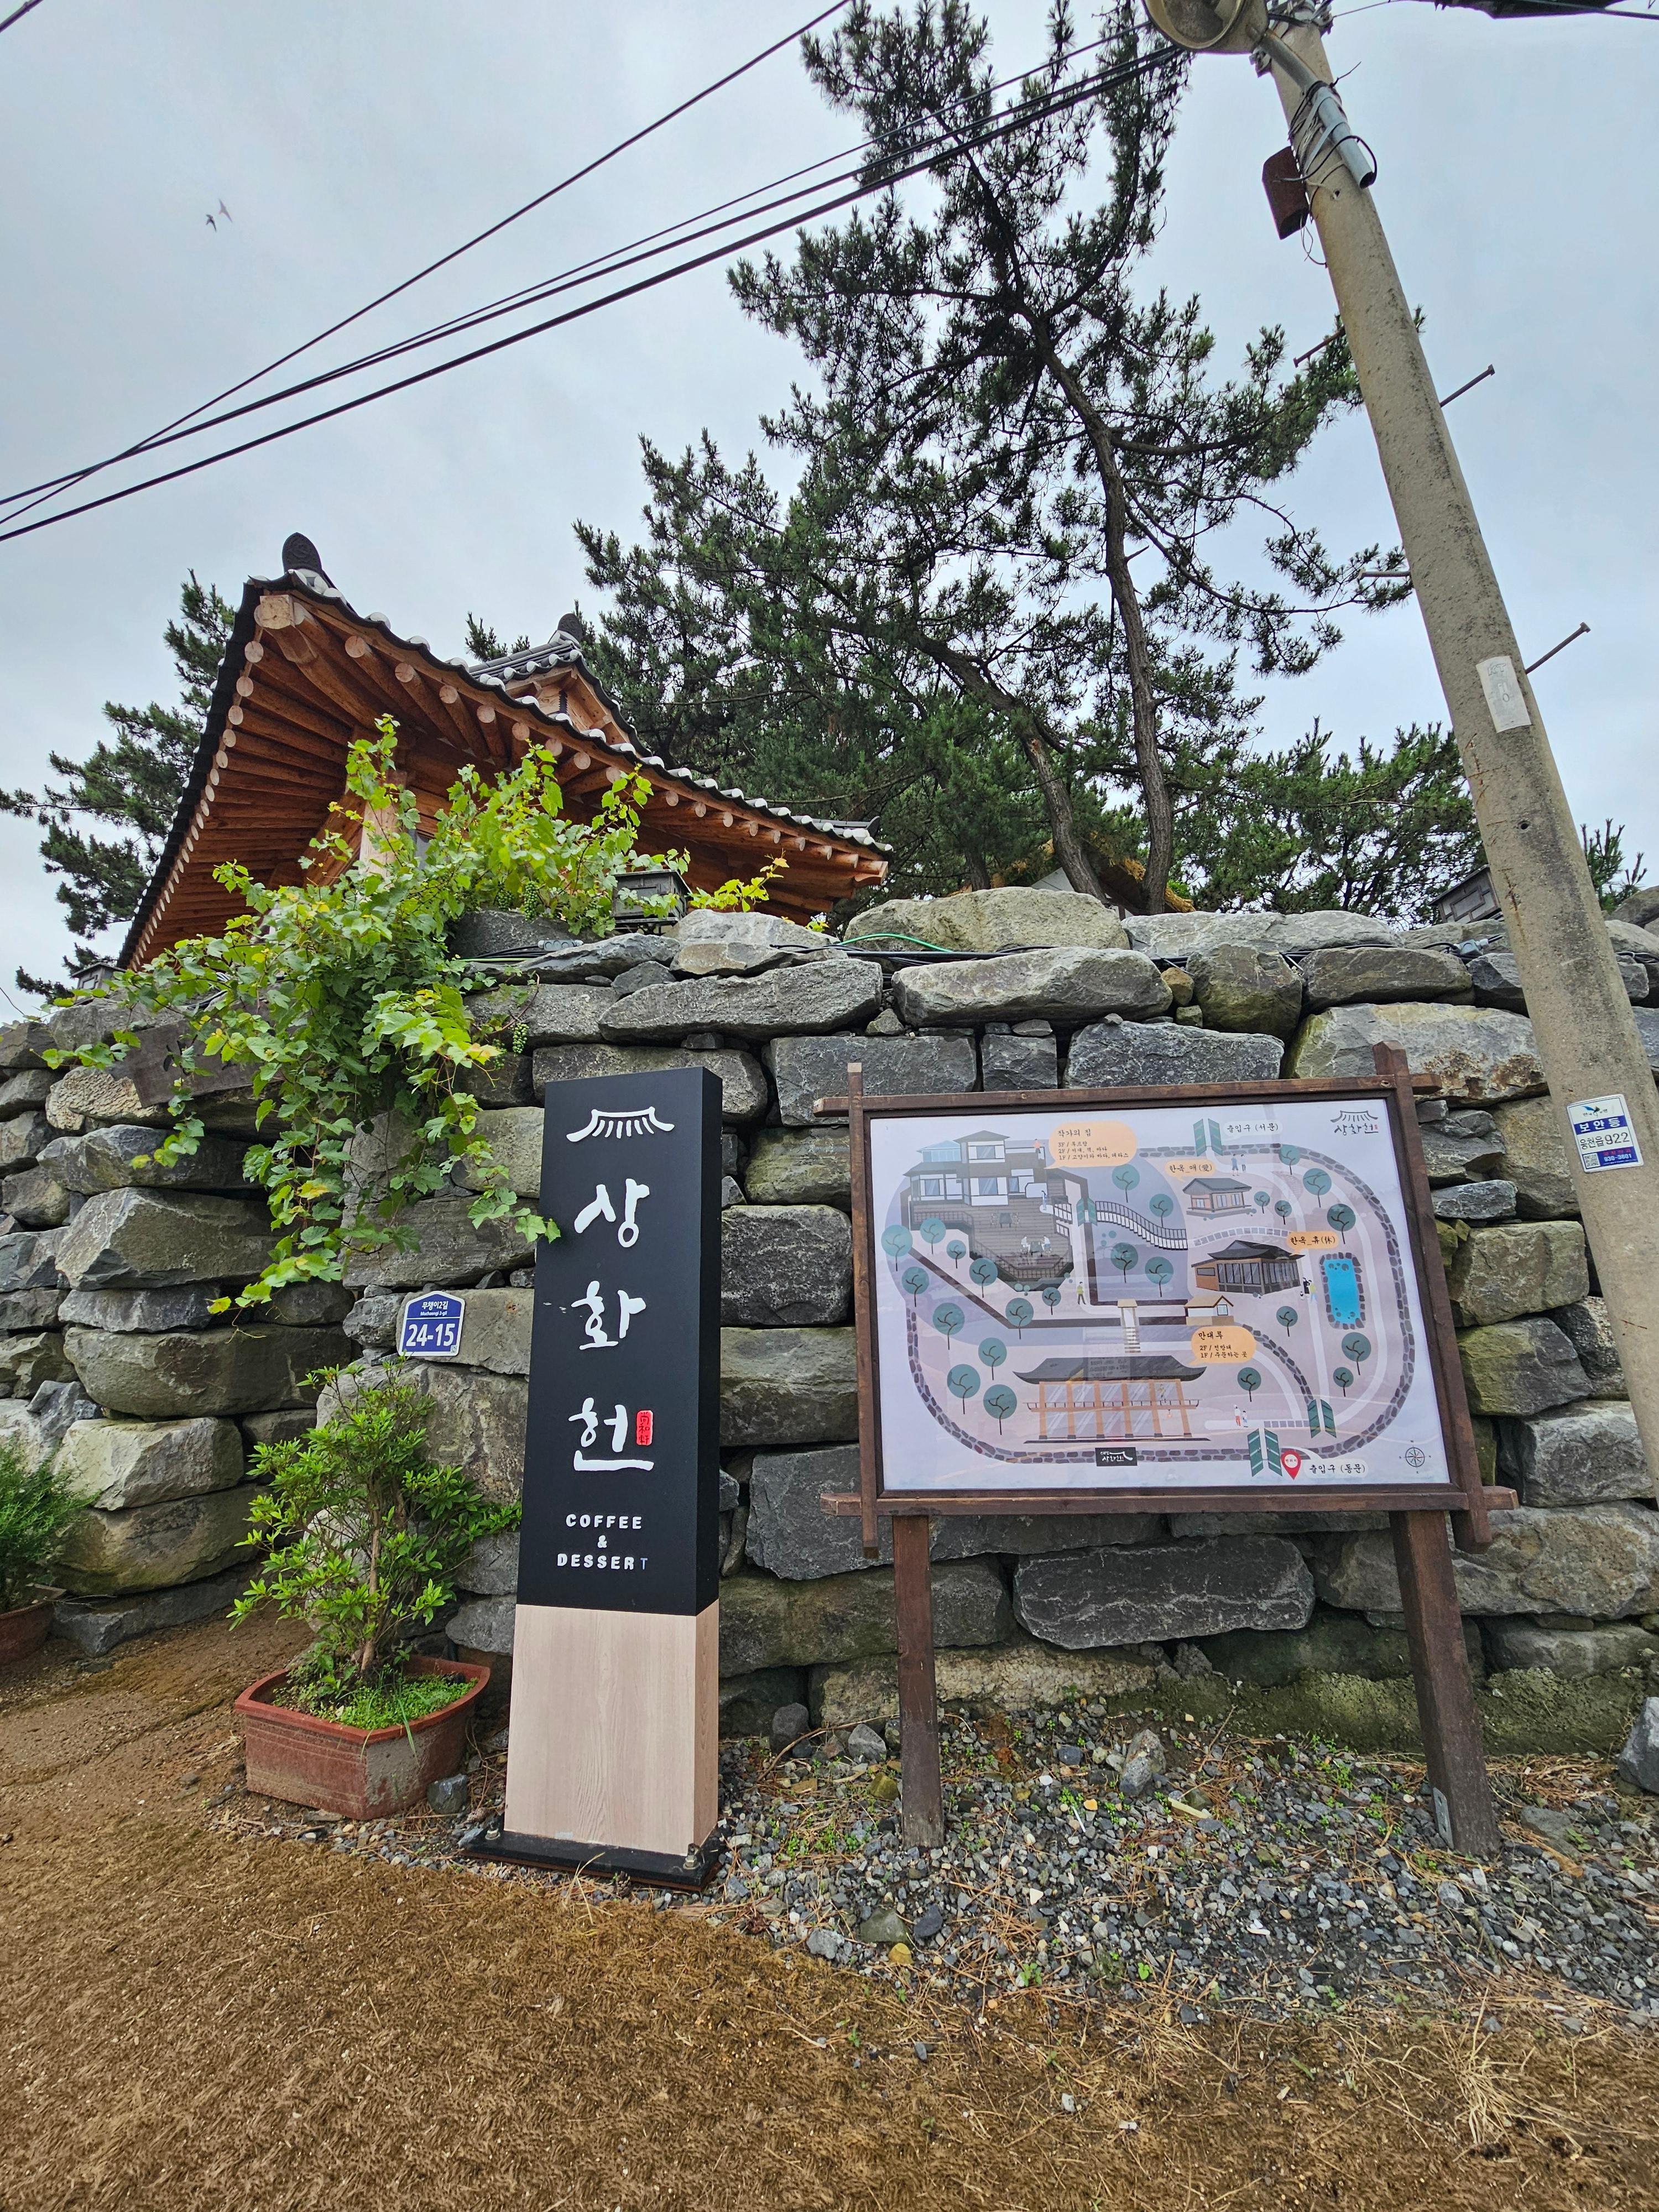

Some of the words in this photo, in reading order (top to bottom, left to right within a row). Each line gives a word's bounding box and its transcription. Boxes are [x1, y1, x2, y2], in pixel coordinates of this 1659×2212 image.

[1085, 1128, 1091, 1136] 집
[1227, 1124, 1251, 1133] 출입구
[1255, 1123, 1279, 1132] (서문)
[1334, 1123, 1379, 1136] 상화헌
[1579, 1117, 1621, 1133] 보안등
[568, 1178, 654, 1471] 상화헌
[406, 1323, 455, 1347] 24-15
[1310, 1464, 1336, 1474] 출입구
[1340, 1464, 1365, 1474] (동문)
[566, 1514, 642, 1529] COFFEE
[597, 1535, 607, 1548] &
[557, 1553, 648, 1570] DESSERT
